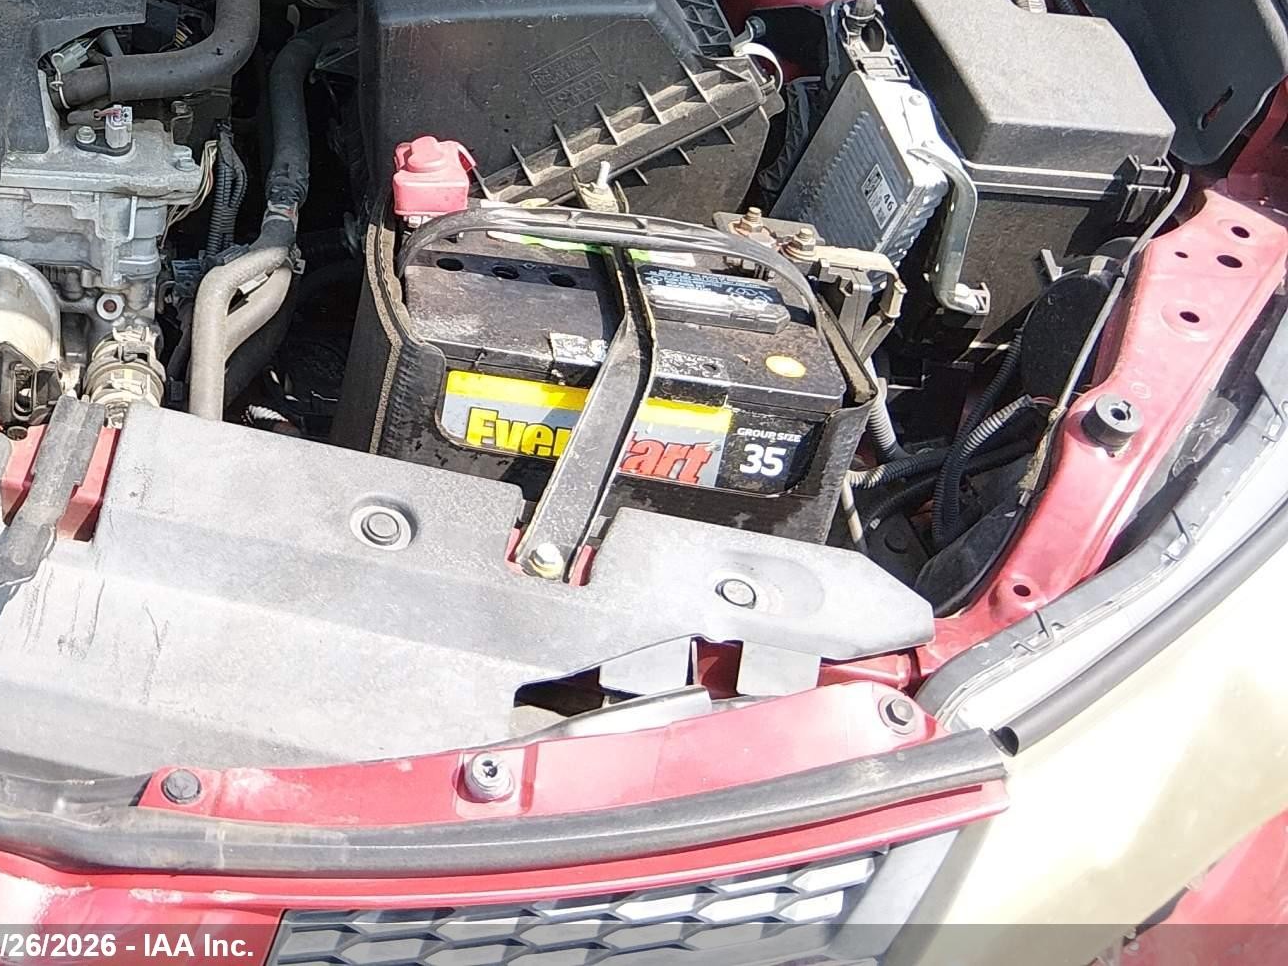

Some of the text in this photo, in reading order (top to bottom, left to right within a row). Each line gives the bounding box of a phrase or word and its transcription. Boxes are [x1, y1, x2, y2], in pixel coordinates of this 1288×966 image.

[736, 426, 804, 443] GROUP SIZE
[738, 443, 788, 477] 35
